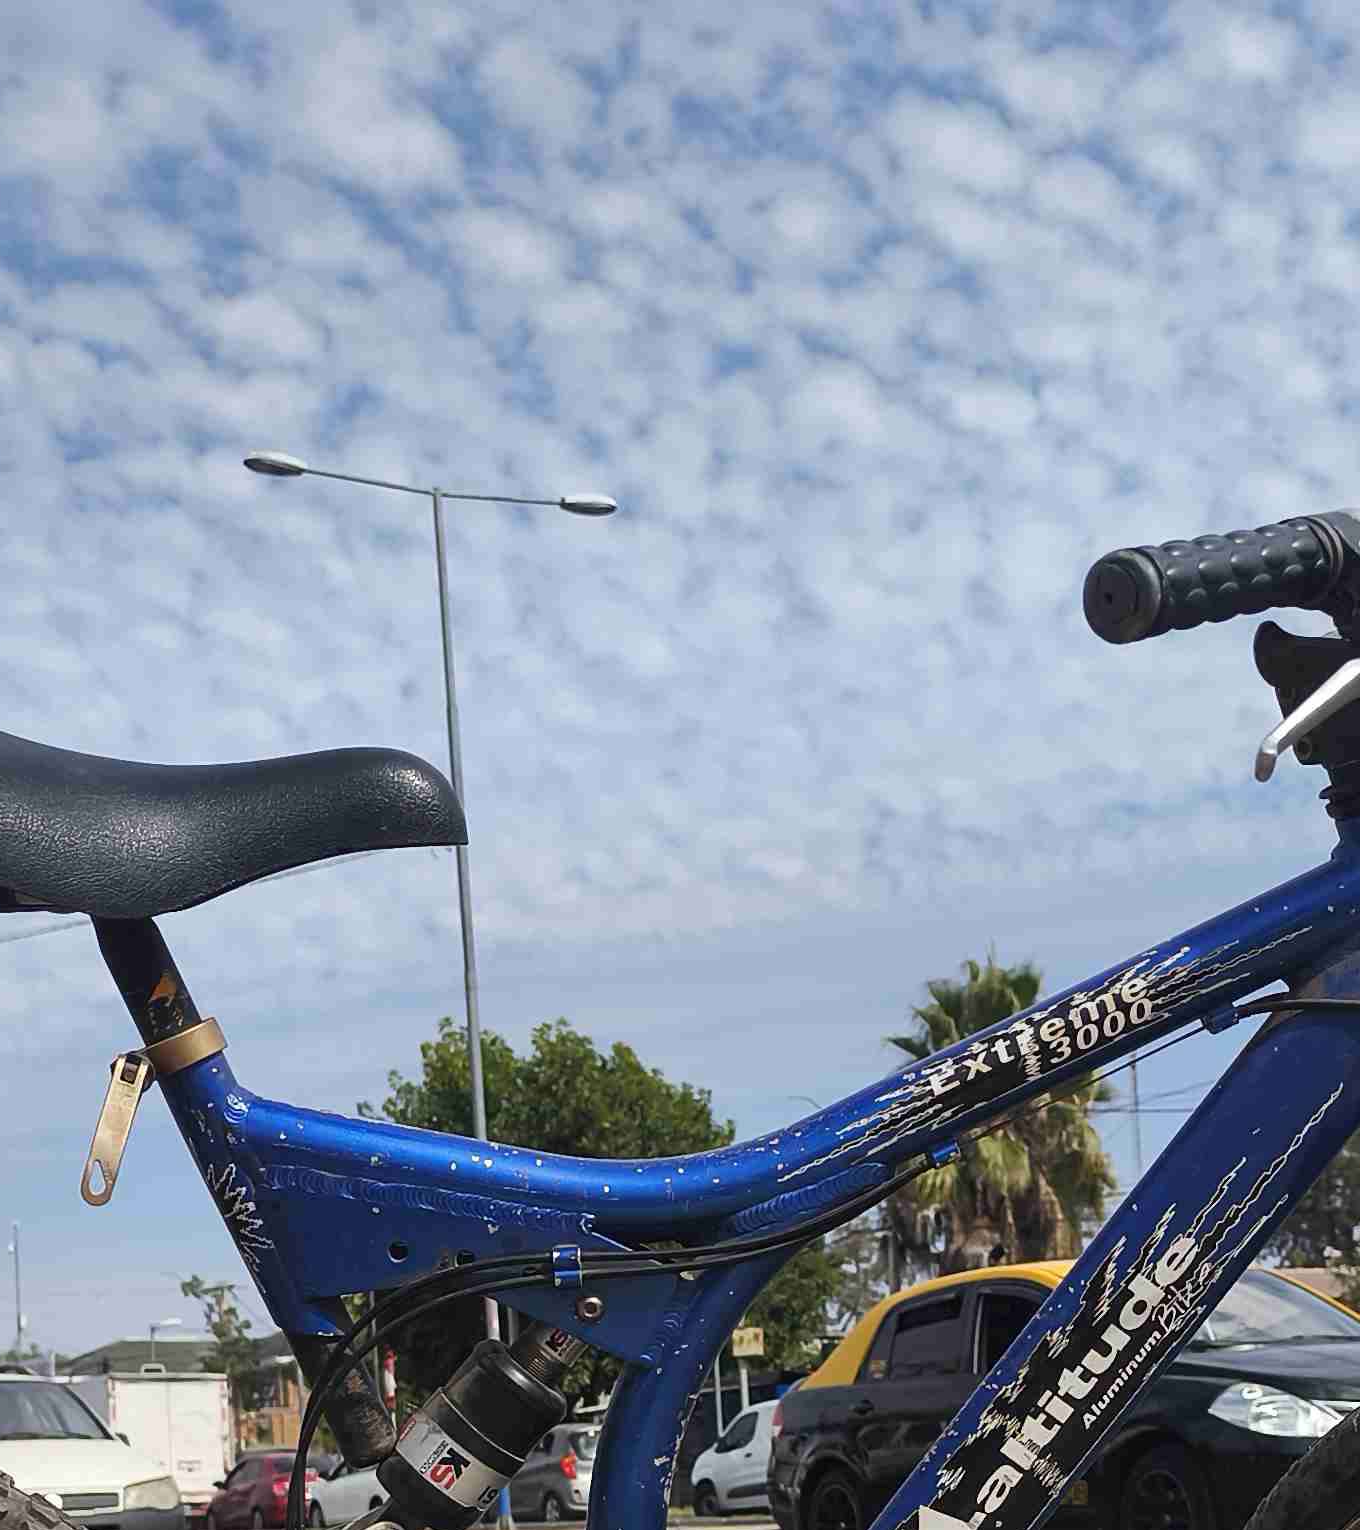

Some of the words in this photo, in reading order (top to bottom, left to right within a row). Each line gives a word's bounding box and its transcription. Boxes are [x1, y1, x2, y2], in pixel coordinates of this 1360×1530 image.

[928, 977, 1148, 1096] Extreme
[1049, 999, 1154, 1064] 3000
[1080, 1331, 1162, 1431] Aluminum
[430, 1447, 472, 1490] KS
